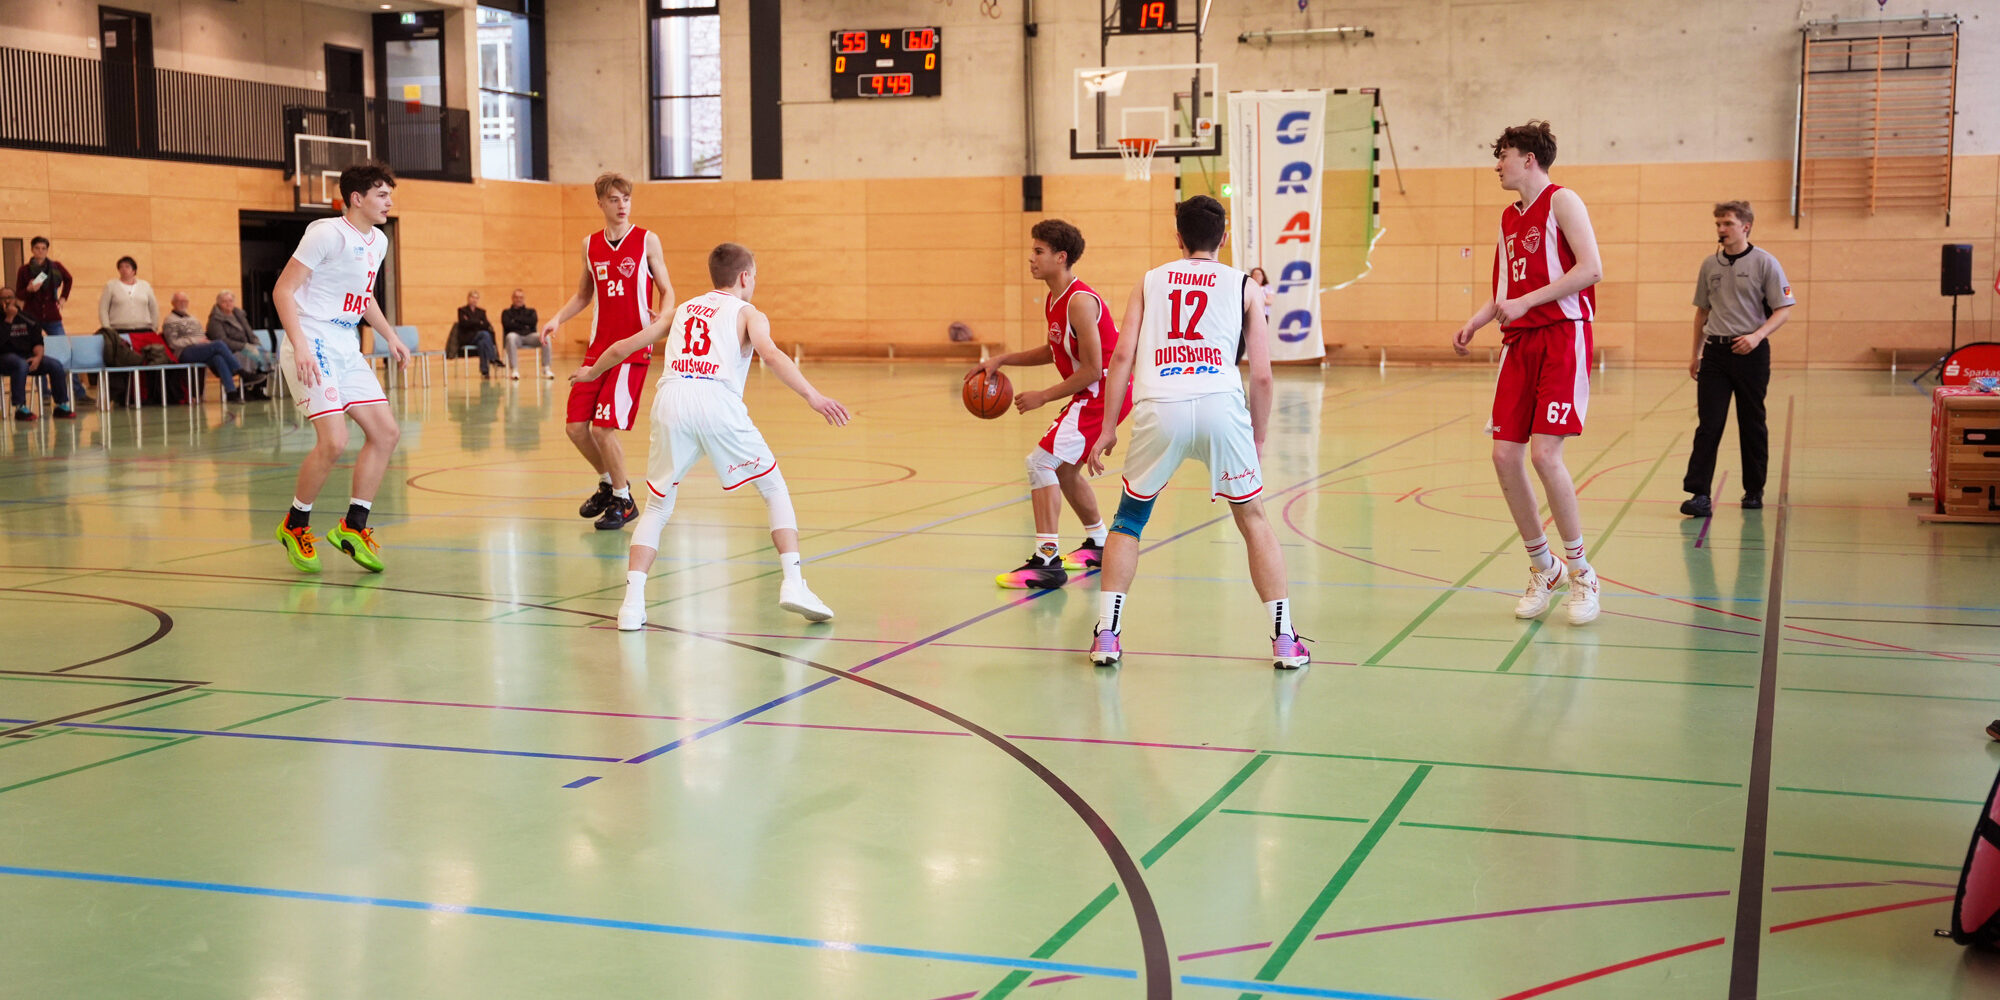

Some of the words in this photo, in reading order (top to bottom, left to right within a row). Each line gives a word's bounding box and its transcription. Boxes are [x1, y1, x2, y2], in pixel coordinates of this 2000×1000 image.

[1140, 2, 1165, 28] 19
[843, 32, 866, 52] 55
[880, 33, 891, 48] 4
[909, 29, 934, 50] 60
[835, 56, 846, 73] 0
[925, 53, 936, 70] 0
[1168, 271, 1217, 287] TRUMIĆ
[1512, 257, 1527, 282] 67
[607, 279, 624, 297] 24
[1168, 289, 1209, 340] 12
[682, 316, 712, 356] 13
[1155, 345, 1222, 367] DUISBURG
[595, 403, 611, 421] 24
[1546, 401, 1572, 425] 67
